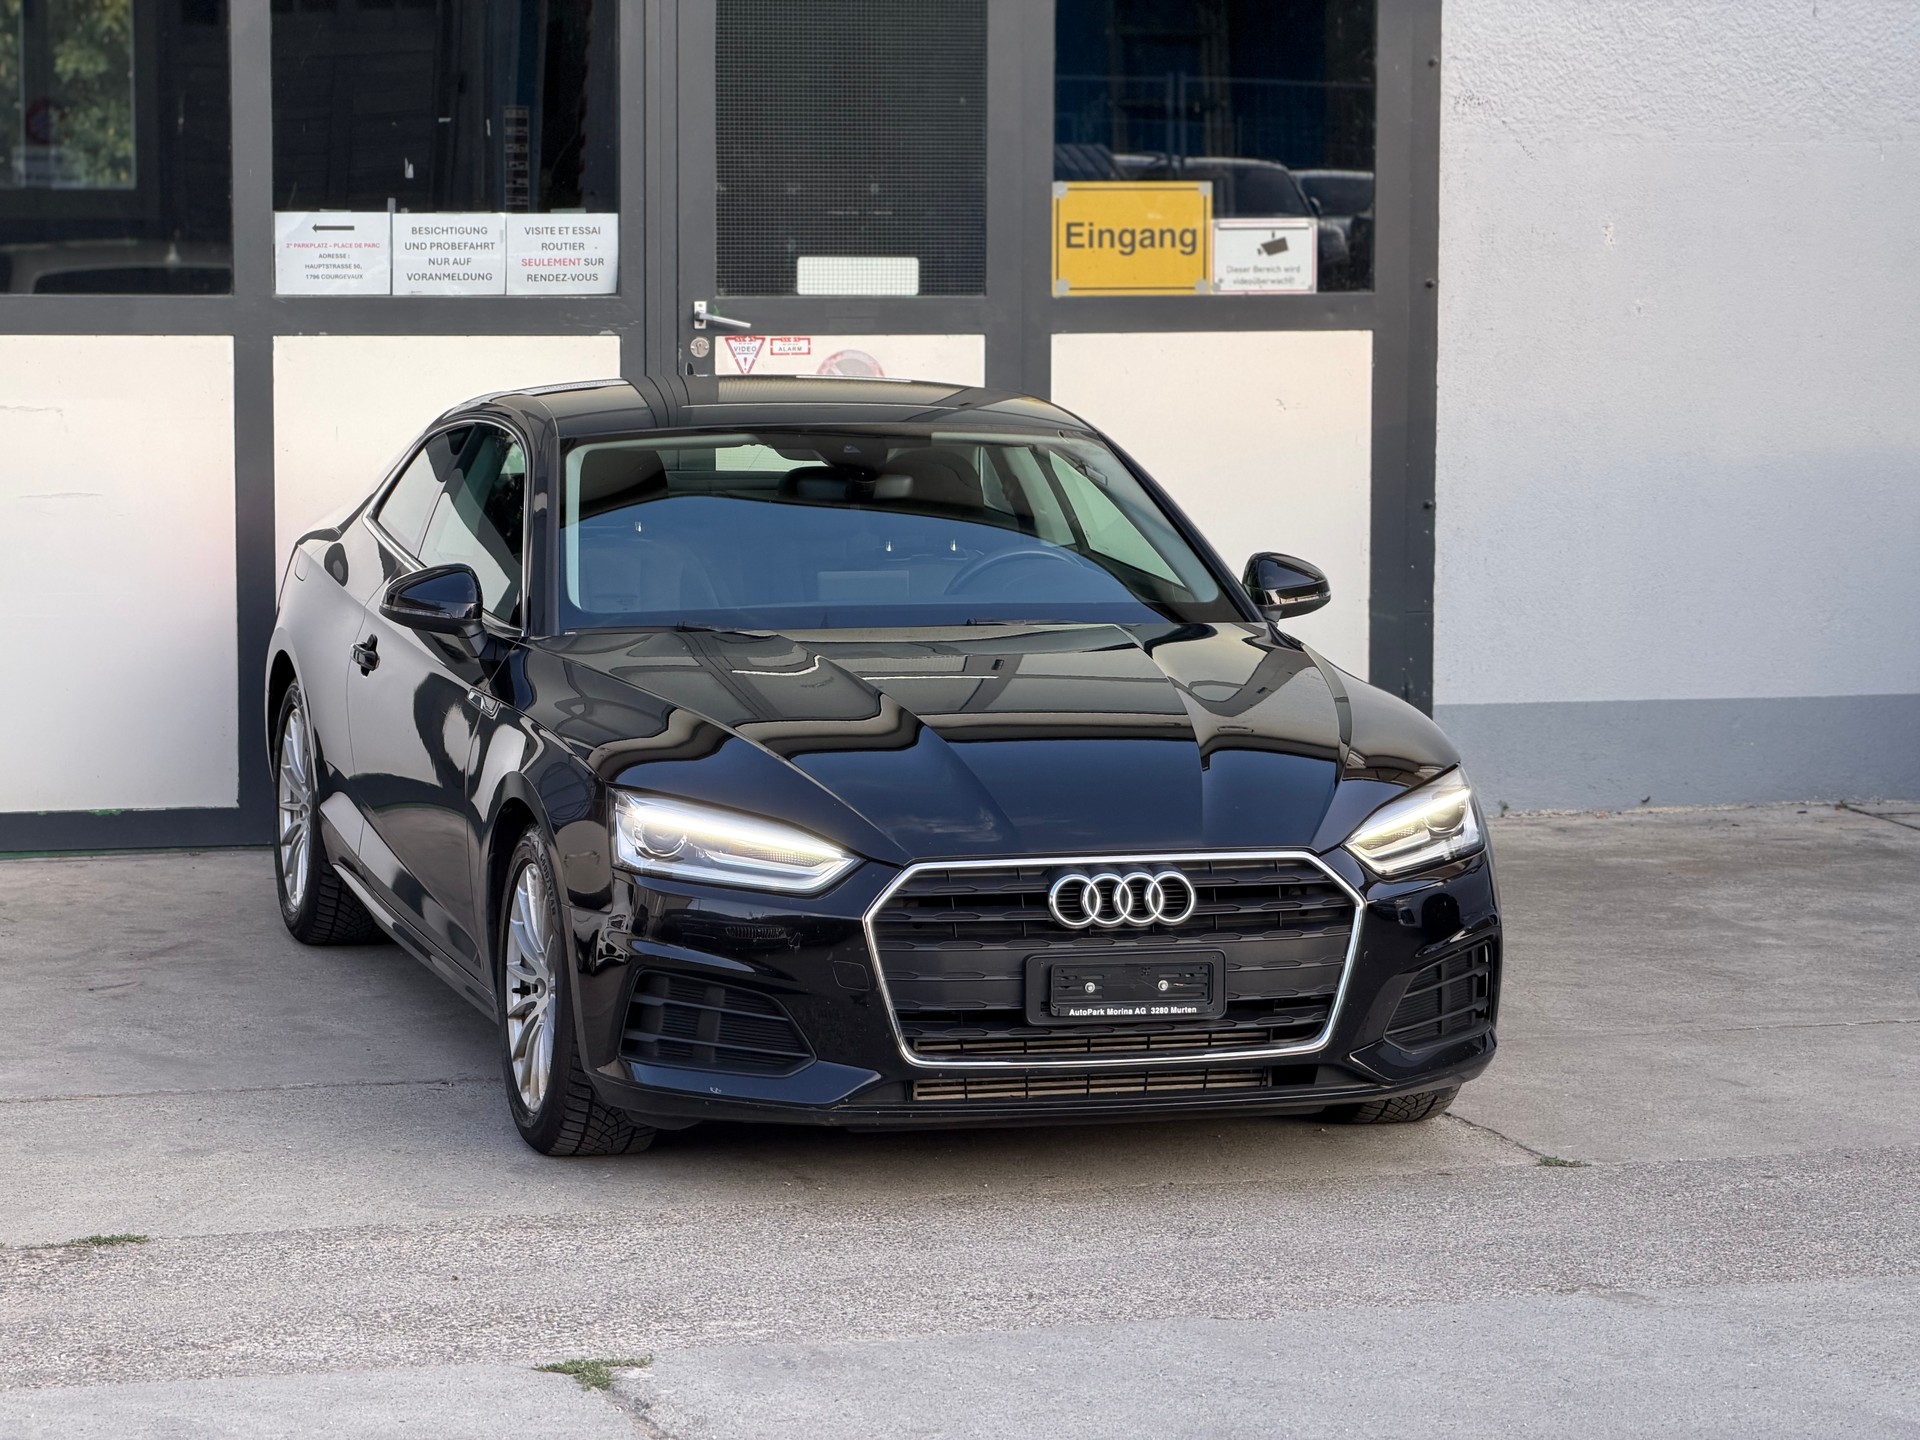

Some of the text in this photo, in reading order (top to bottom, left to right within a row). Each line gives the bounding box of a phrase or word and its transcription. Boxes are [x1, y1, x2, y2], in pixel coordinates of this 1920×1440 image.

[411, 226, 488, 236] BESICHTIGUNG
[524, 226, 601, 236] VISITE ET ESSAI
[1065, 221, 1197, 257] Eingang
[404, 241, 496, 251] UND PROBEFAHRT
[541, 242, 585, 251] ROUTIER
[428, 257, 472, 266] NUR AUF
[521, 257, 605, 267] SEULEMENT SUR
[1226, 265, 1301, 274] Dieser Bereich wird
[406, 272, 493, 282] VORANMELDUNG
[526, 272, 599, 283] RENDEZ-VOUS
[1068, 1005, 1198, 1016] AutoPark Morina AG 3280 Murten
